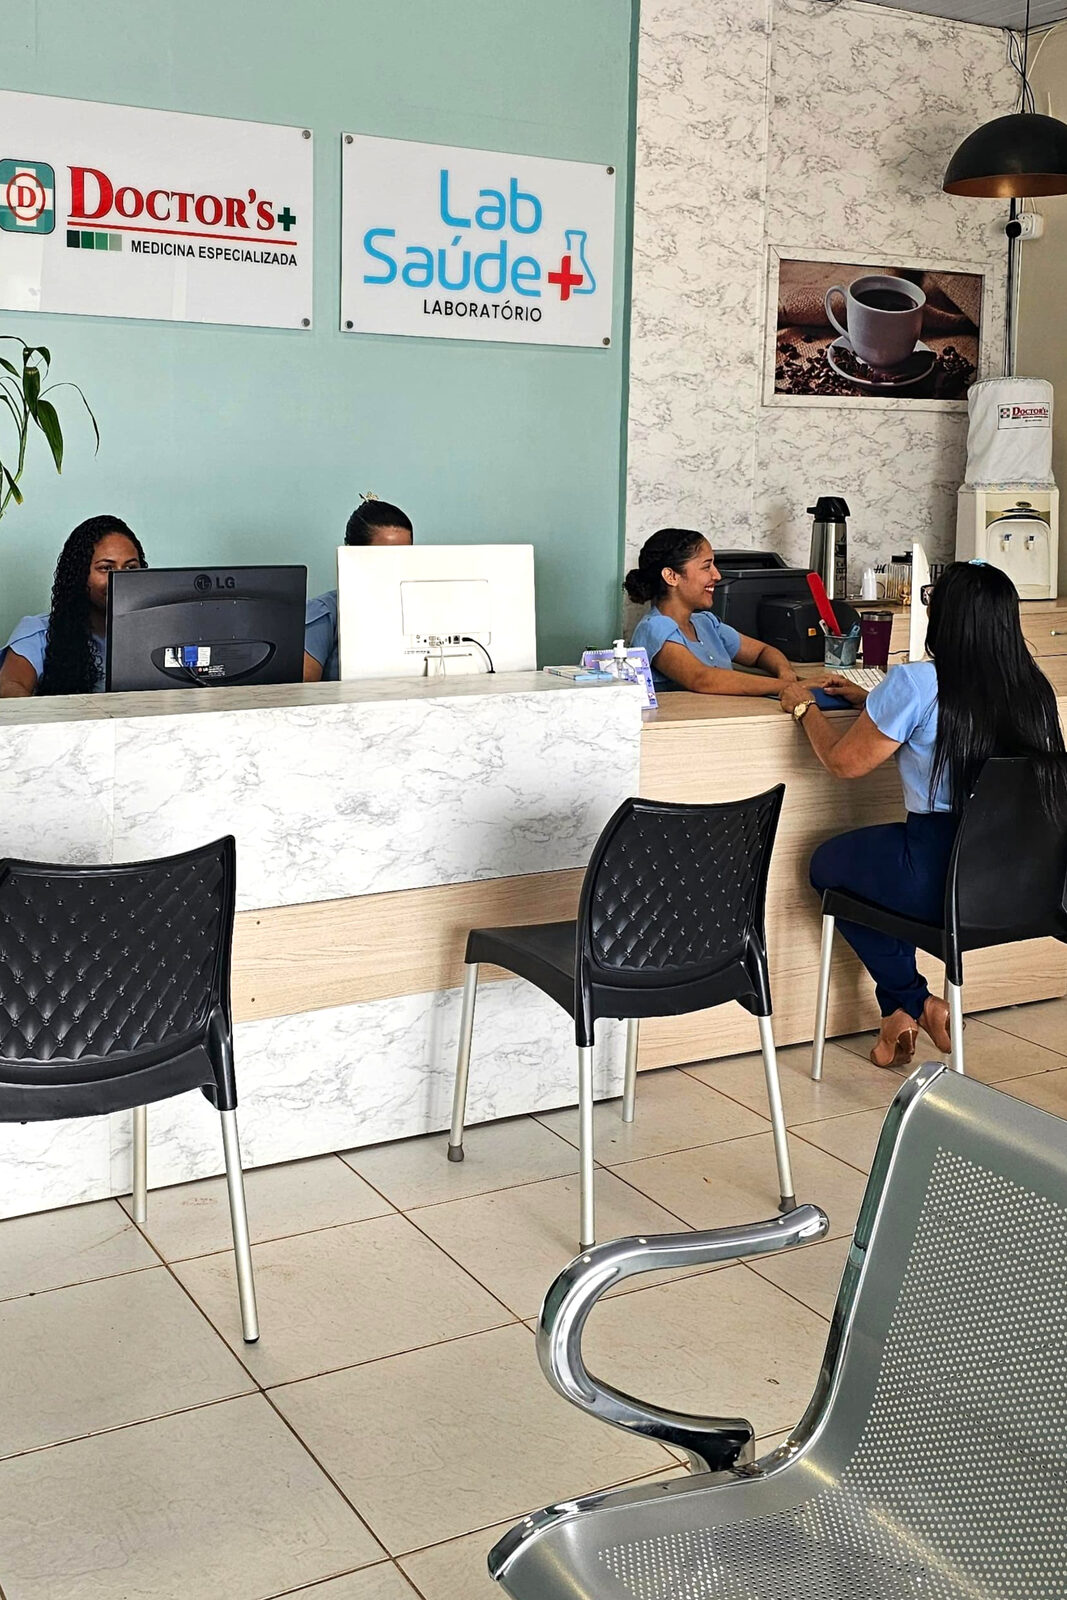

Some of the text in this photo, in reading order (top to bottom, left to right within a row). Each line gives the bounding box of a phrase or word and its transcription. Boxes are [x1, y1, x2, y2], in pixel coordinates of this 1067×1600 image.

[440, 169, 543, 235] Lab
[131, 239, 298, 267] MEDICINA ESPECIALIZADA
[363, 227, 542, 298] Saúde
[423, 299, 543, 322] LABORATÓRIO
[215, 576, 236, 589] LG
